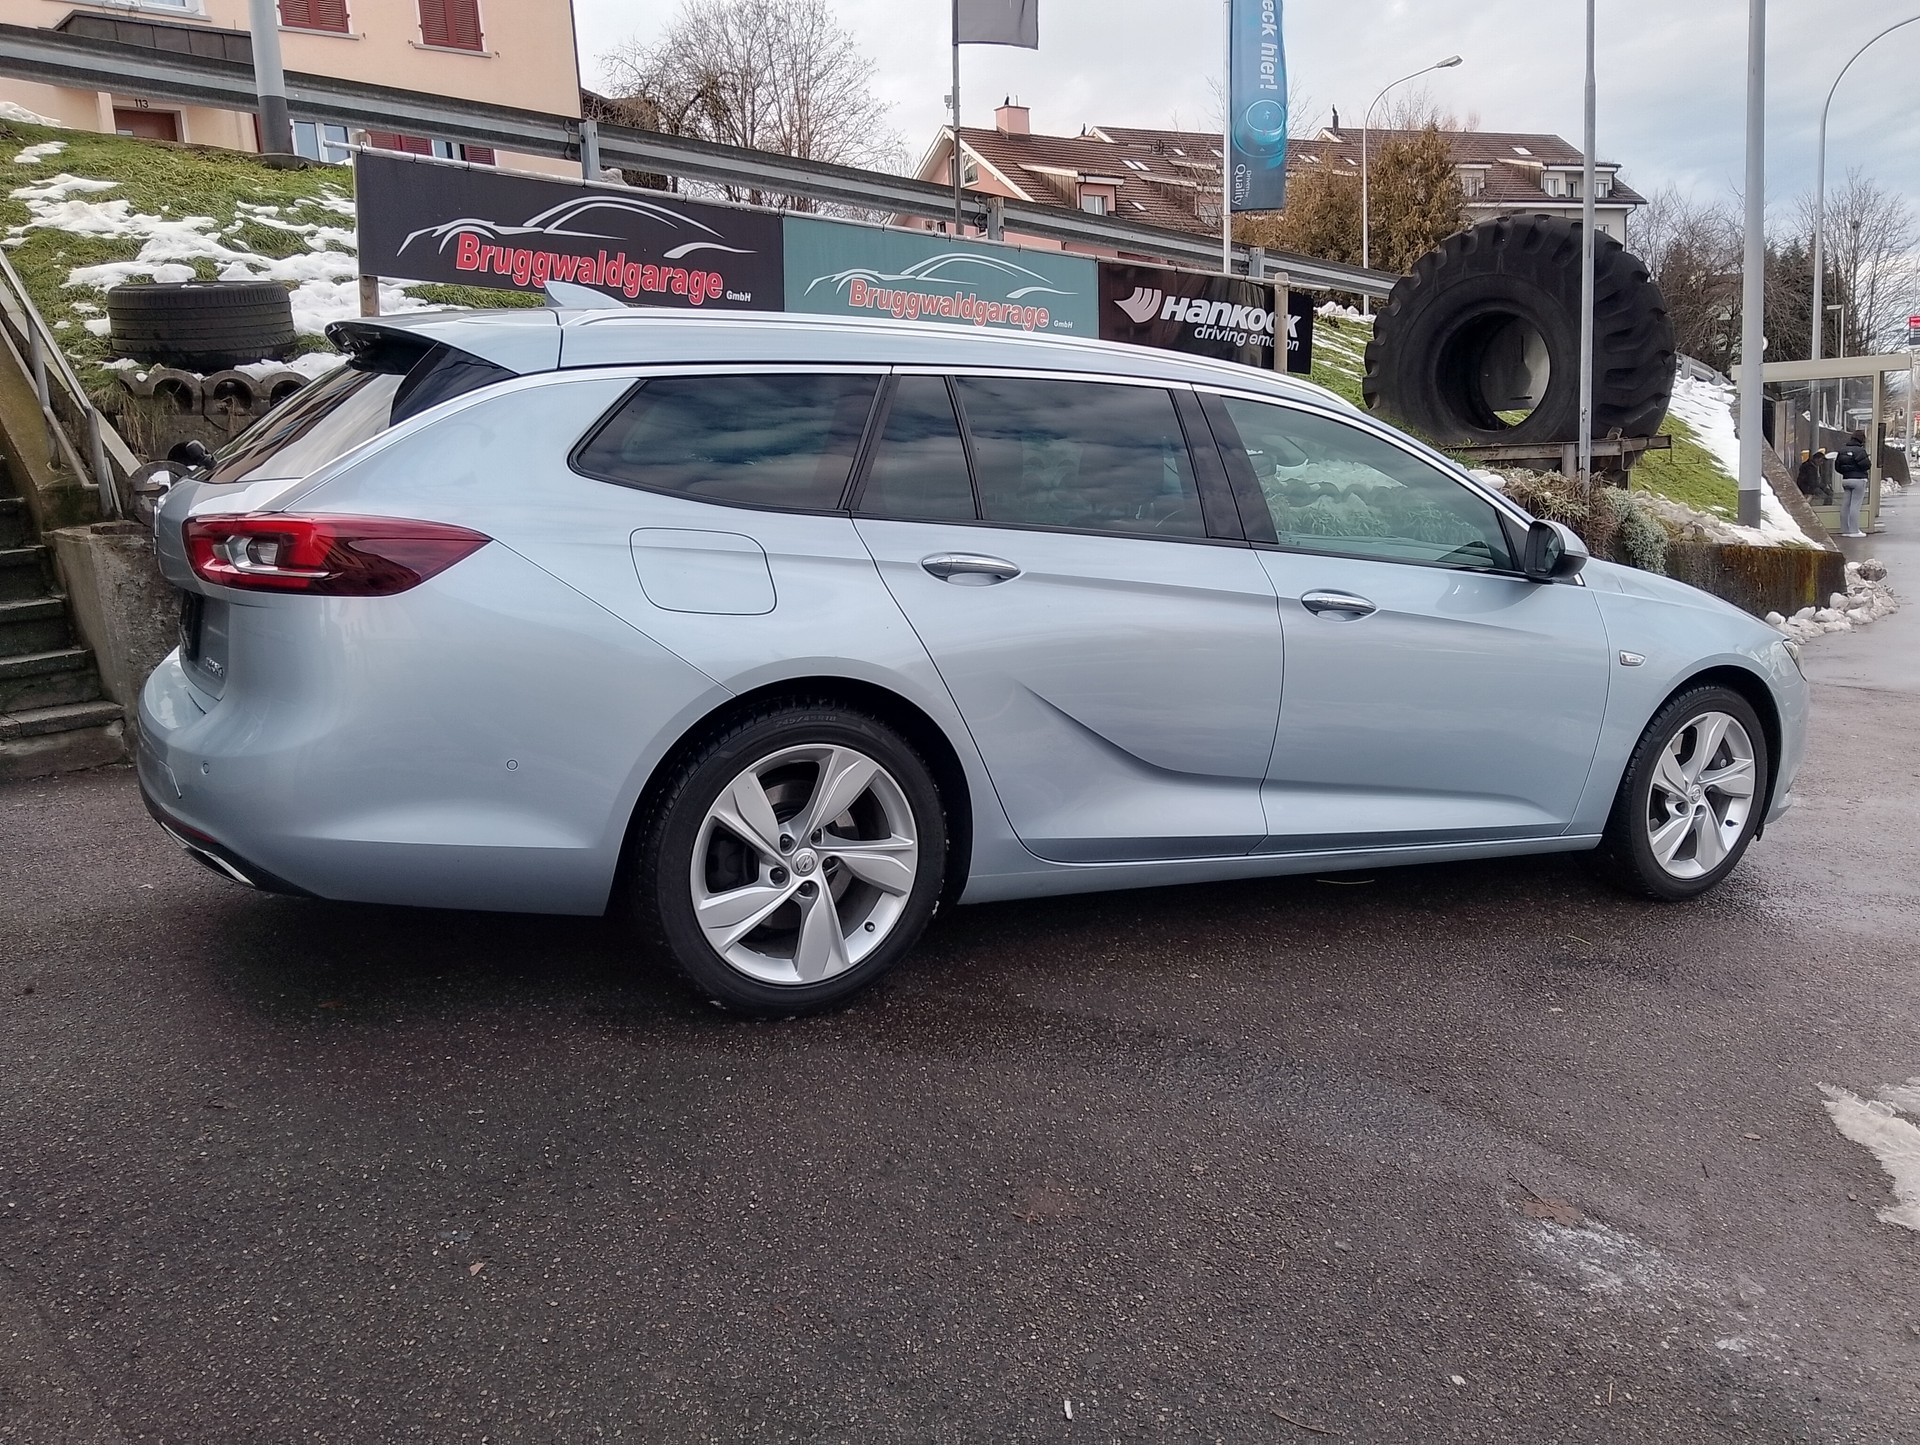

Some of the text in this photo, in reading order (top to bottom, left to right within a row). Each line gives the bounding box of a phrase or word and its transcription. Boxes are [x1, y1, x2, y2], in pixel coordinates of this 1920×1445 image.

[1260, 42, 1278, 90] hier!
[135, 98, 149, 109] 113
[1231, 163, 1246, 206] Quality
[456, 232, 752, 306] Bruggwaldgarage GmbH
[849, 278, 1074, 332] Bruggwaldgarage GmbH
[1194, 324, 1248, 347] driving
